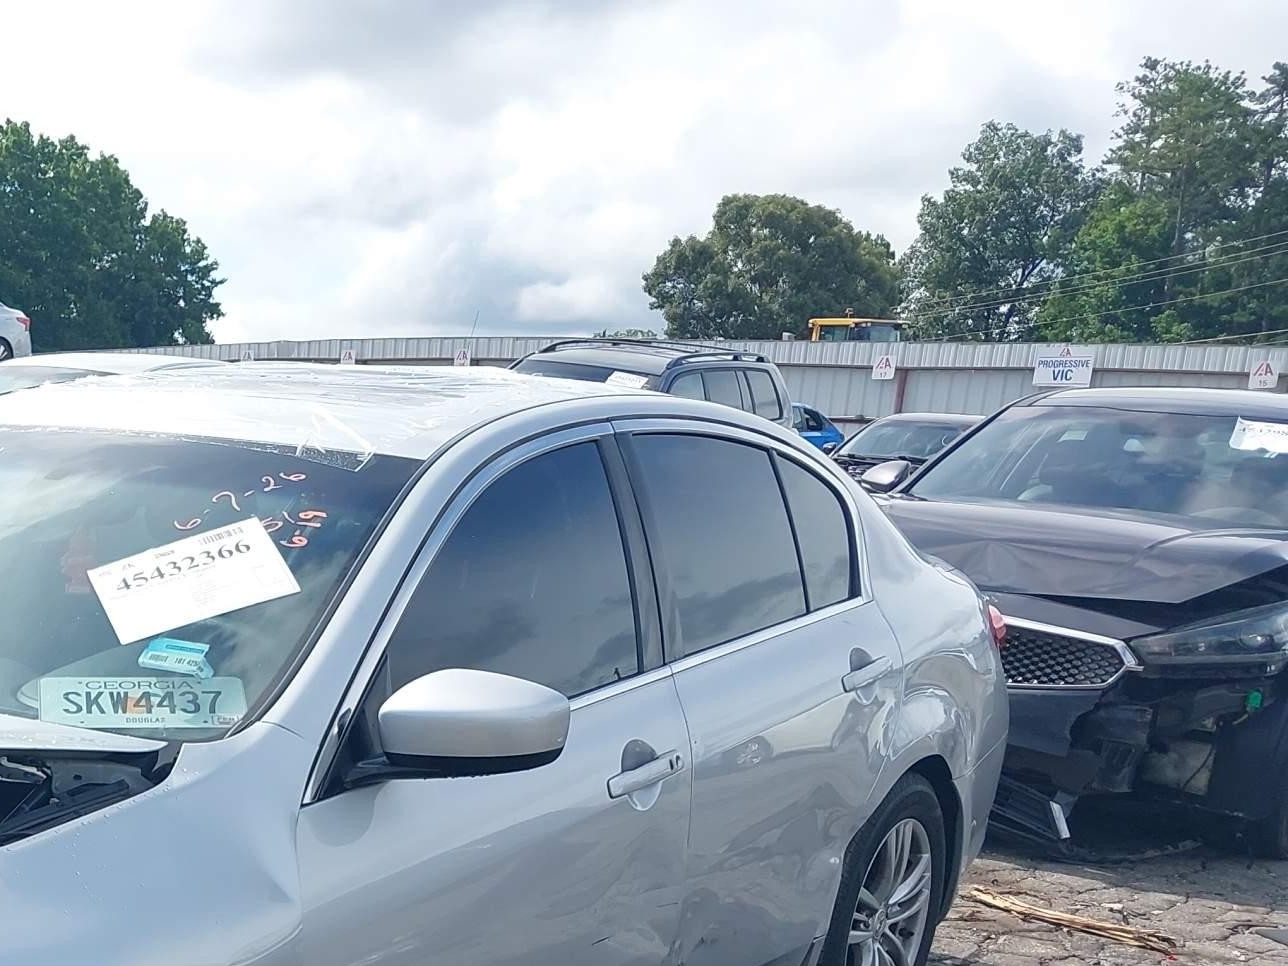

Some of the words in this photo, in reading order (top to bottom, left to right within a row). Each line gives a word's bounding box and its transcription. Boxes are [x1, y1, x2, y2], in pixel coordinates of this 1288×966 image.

[1037, 359, 1091, 369] PROGRESSIVE
[1052, 369, 1074, 381] VIC
[116, 539, 251, 592] 45432366
[85, 680, 195, 691] GEORGIA
[62, 690, 222, 715] SKW4437
